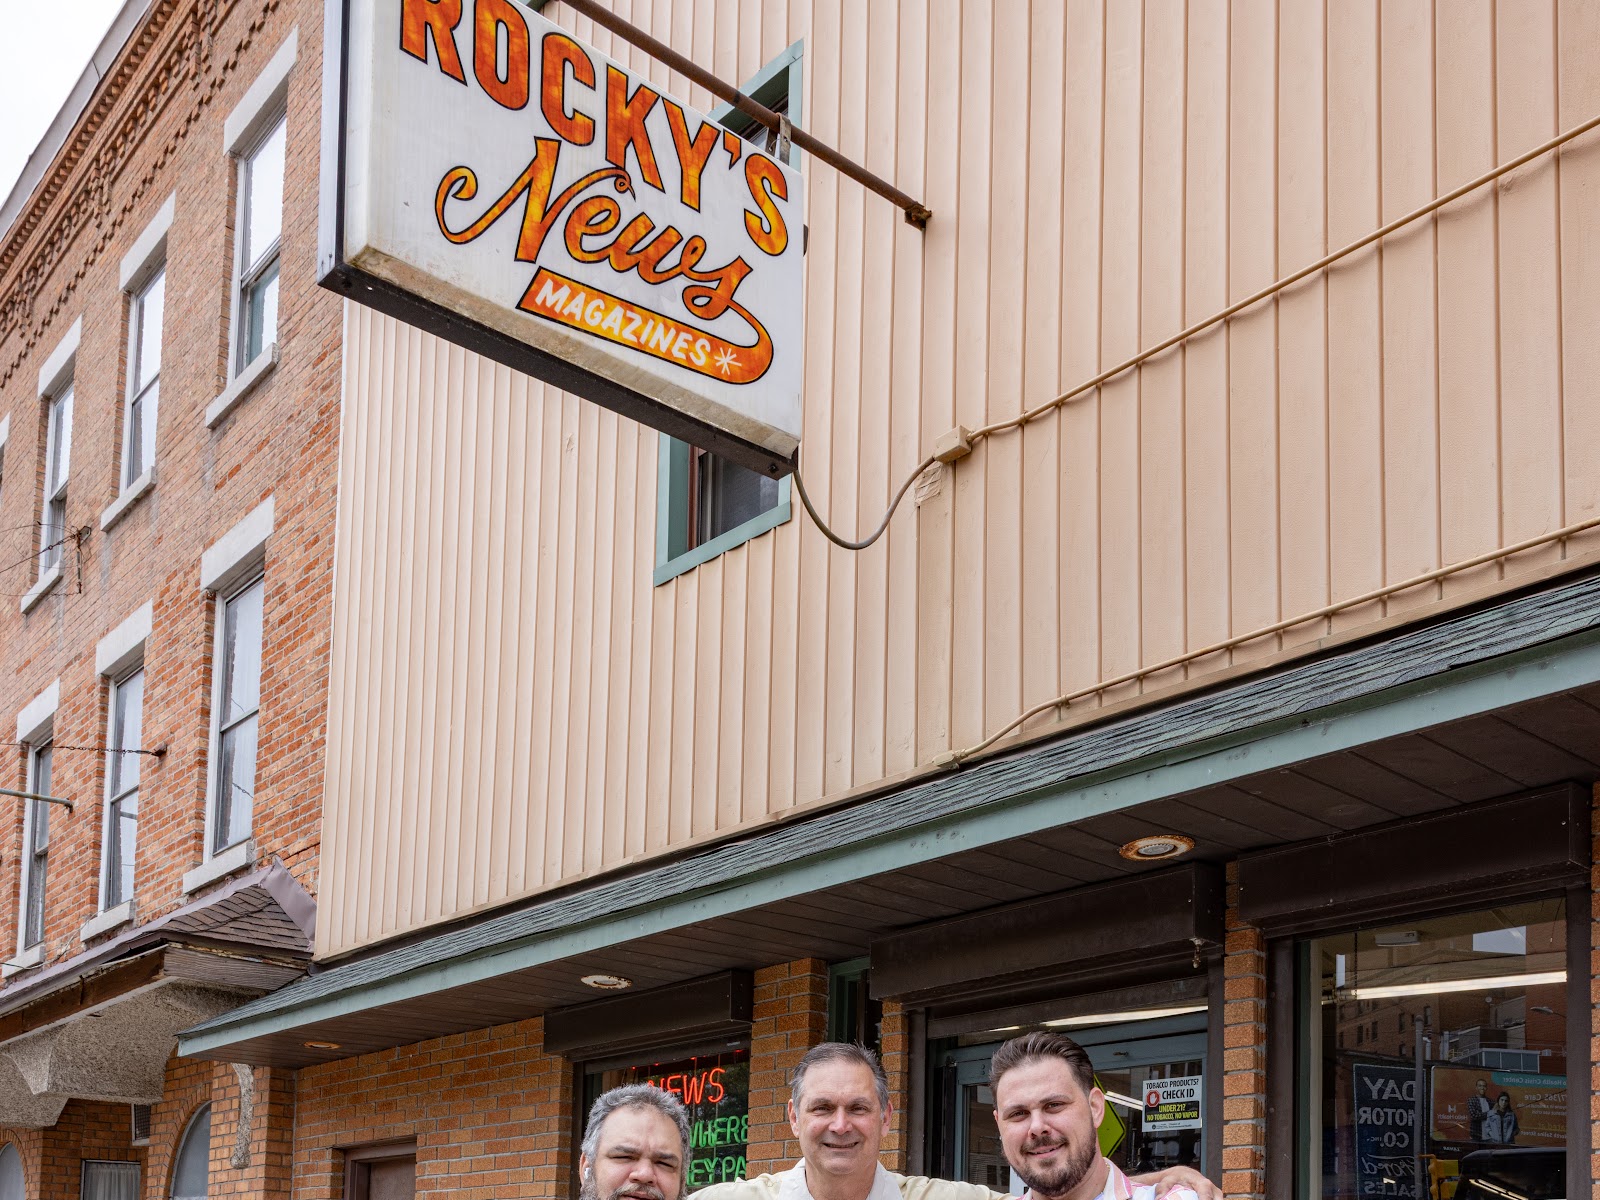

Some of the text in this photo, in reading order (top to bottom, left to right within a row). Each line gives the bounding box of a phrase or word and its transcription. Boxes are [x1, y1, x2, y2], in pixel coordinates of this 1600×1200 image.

[400, 0, 789, 256] ROCKY'S
[435, 137, 754, 321] News
[534, 279, 712, 367] MAGAZINES
[1146, 1079, 1199, 1090] TOBACCO PRODUCTS?
[1159, 1104, 1176, 1112] UNDER
[1162, 1088, 1194, 1099] CHECK ID
